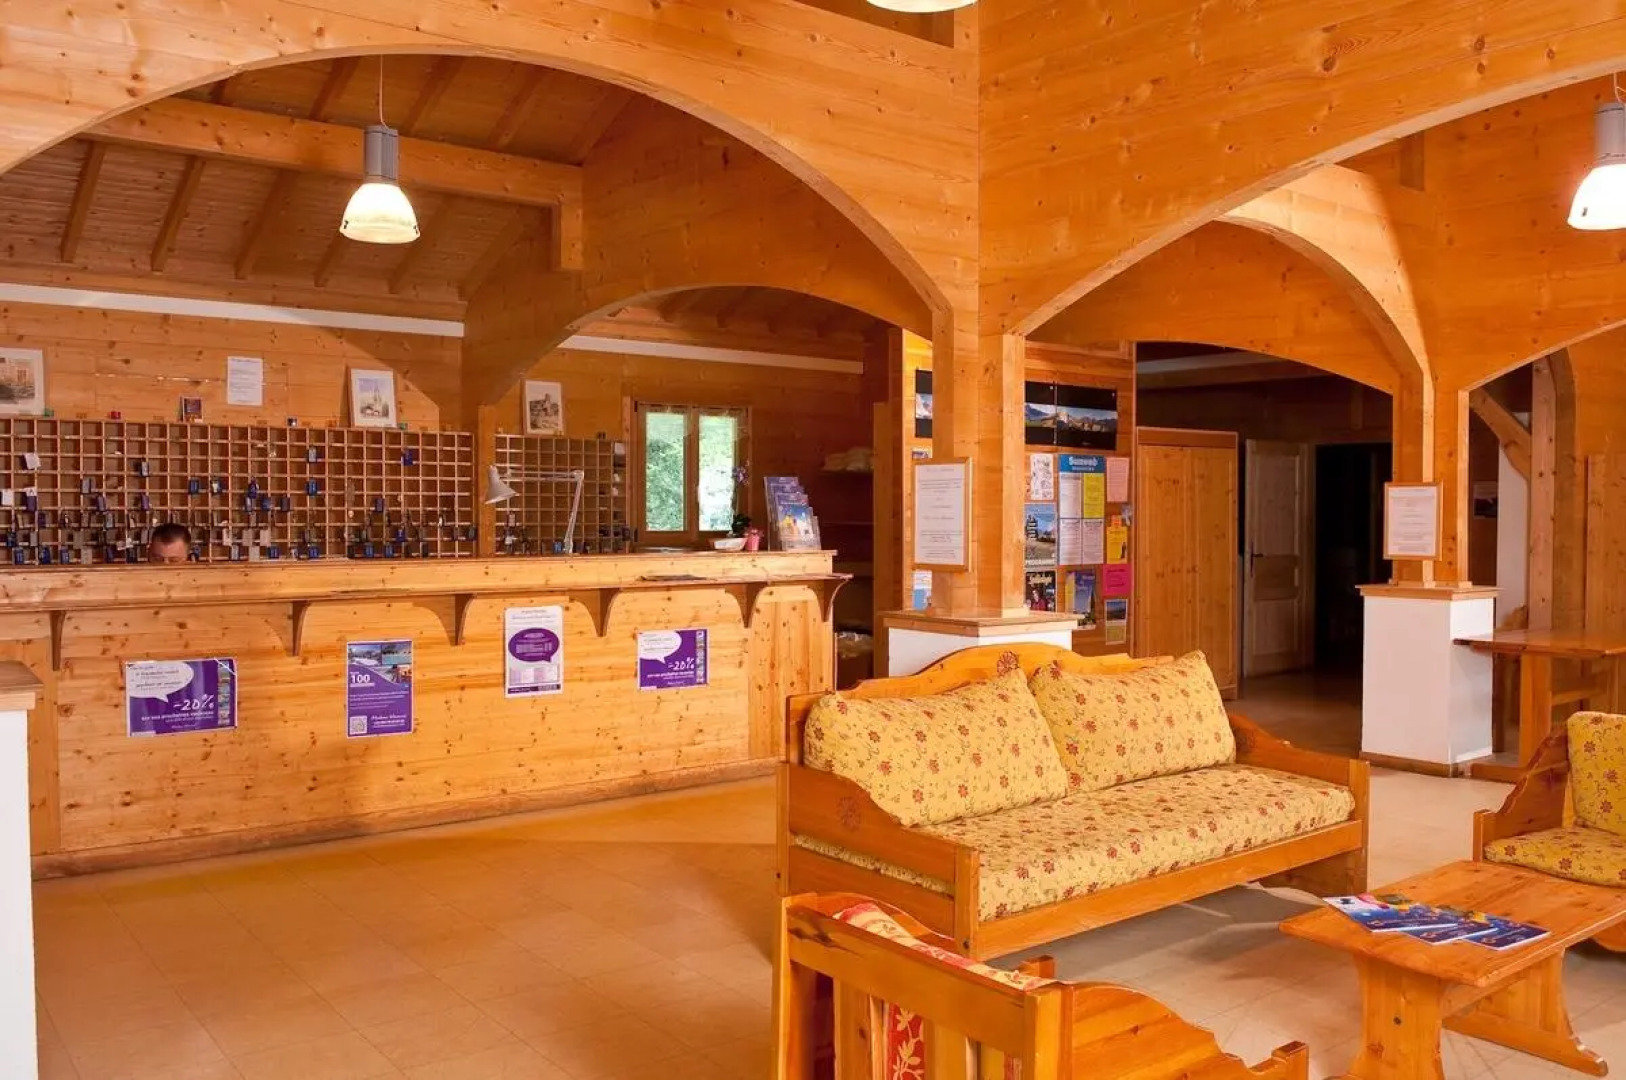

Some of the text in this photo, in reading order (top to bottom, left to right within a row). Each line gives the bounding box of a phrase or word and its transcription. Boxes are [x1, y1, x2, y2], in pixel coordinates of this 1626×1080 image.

[668, 657, 695, 670] -20%
[351, 674, 371, 683] 100
[174, 694, 215, 711] -20%
